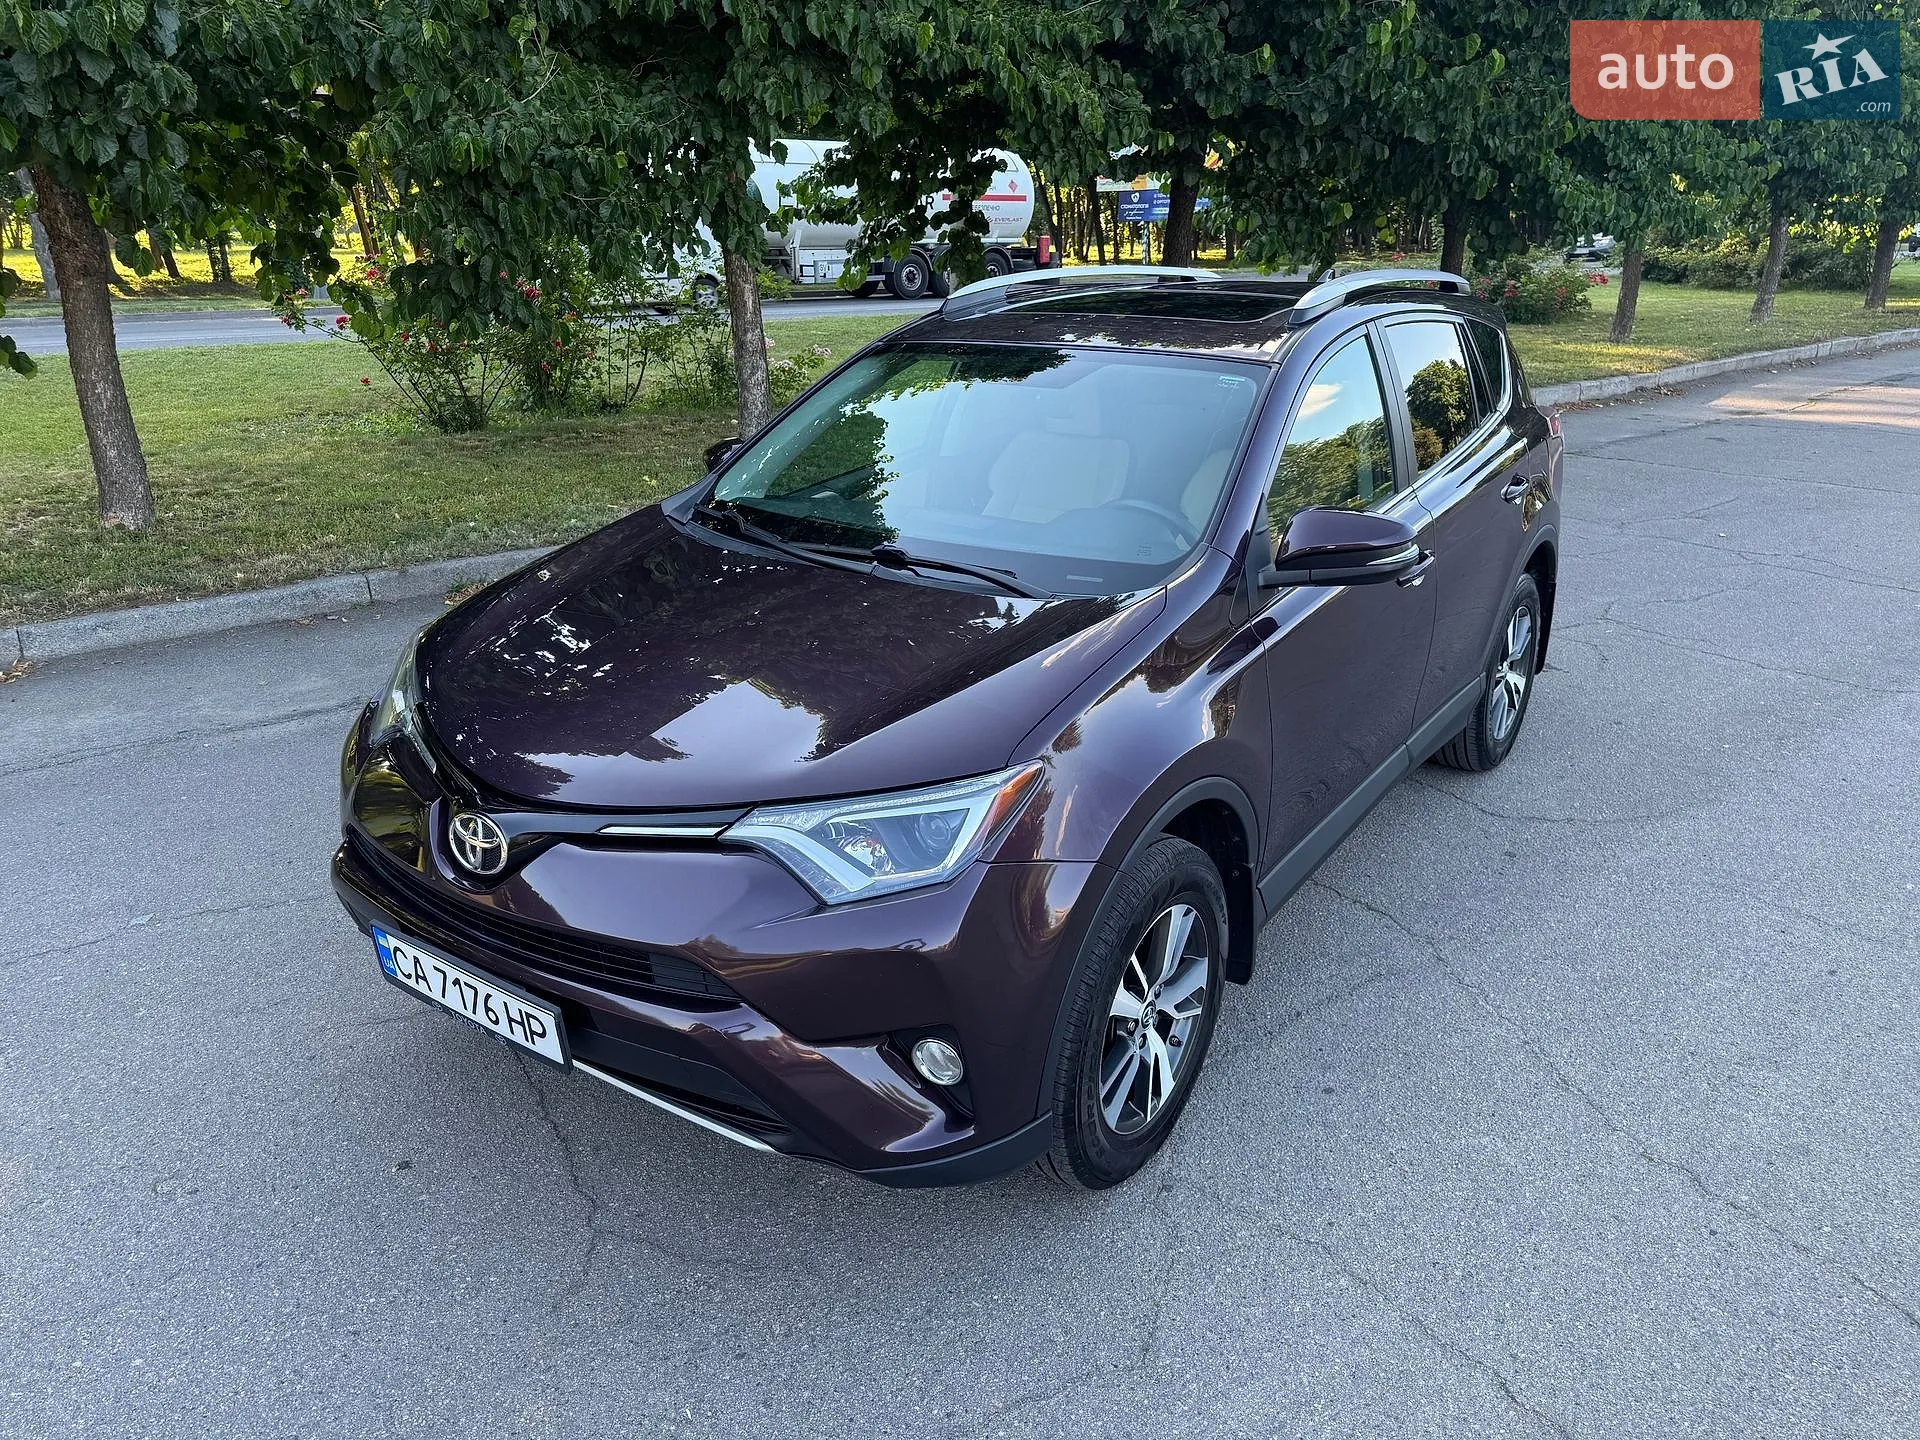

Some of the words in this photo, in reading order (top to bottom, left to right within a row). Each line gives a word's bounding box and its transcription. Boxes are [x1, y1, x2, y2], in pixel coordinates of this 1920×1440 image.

[384, 958, 396, 970] UA
[393, 946, 432, 992] CA
[433, 965, 500, 1026] 7176
[503, 1001, 547, 1045] HP
[450, 1011, 488, 1035] TOYOTA
